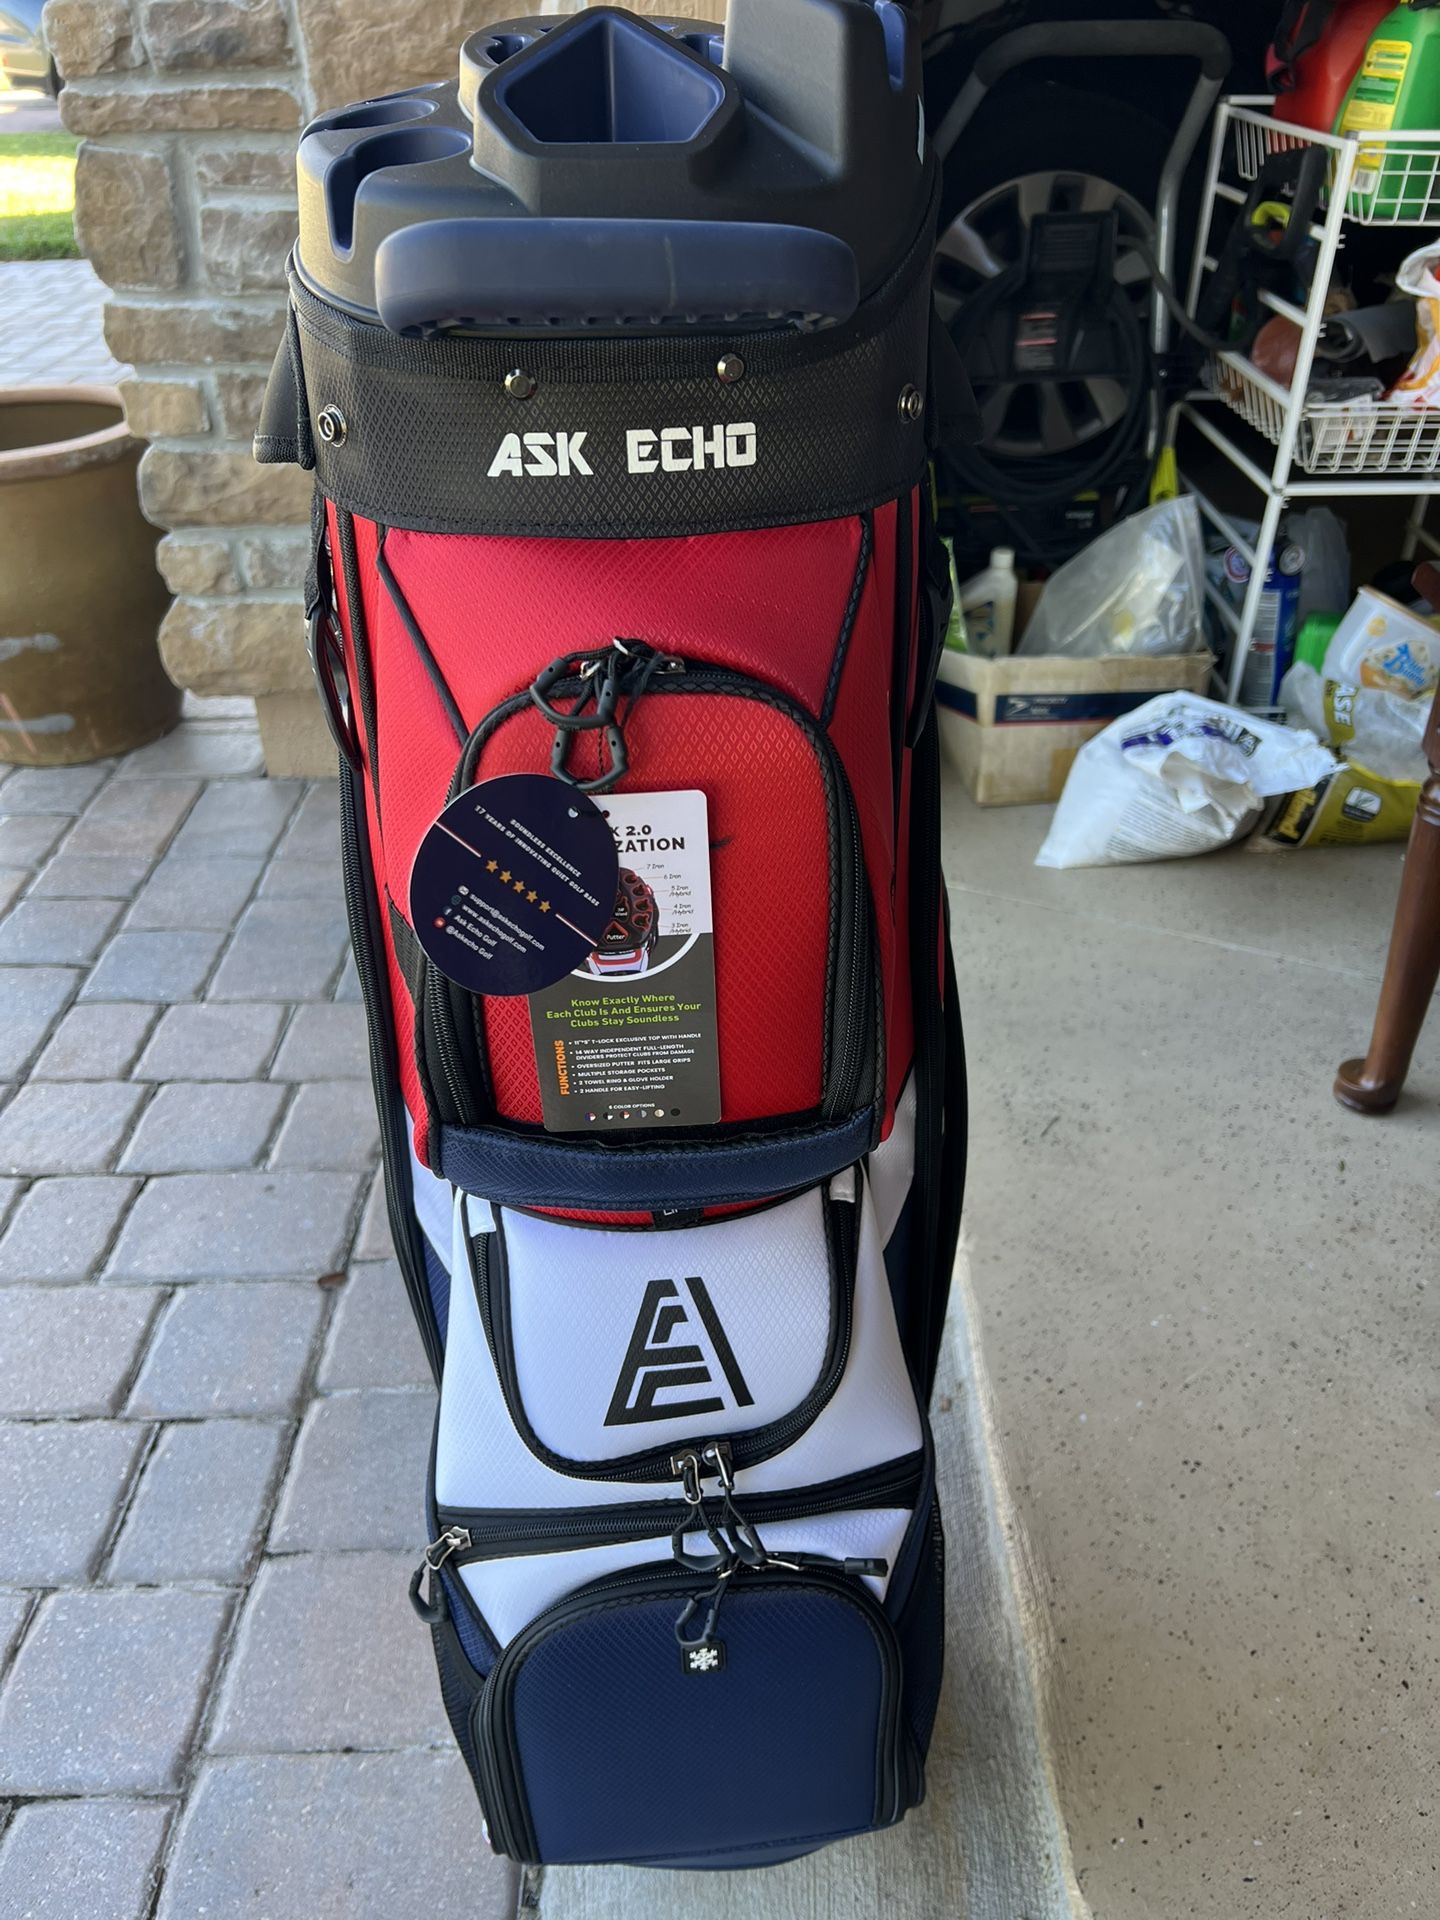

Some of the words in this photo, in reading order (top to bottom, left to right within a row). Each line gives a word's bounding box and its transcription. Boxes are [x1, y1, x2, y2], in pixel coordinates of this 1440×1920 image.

[486, 431, 594, 477] ASK
[626, 421, 757, 474] ECHO
[625, 824, 652, 836] 2.0
[474, 805, 486, 815] 17
[484, 813, 506, 833] YEARS
[505, 829, 516, 839] OF
[514, 837, 552, 868] INNOVATING
[551, 866, 570, 882] QUIET
[569, 881, 585, 894] GOLF
[583, 891, 600, 907] BAGS
[509, 819, 546, 849] SOUNDLESS
[545, 847, 582, 878] EXCELLENCE
[453, 915, 467, 927] Ask
[466, 923, 483, 938] Echo
[482, 934, 498, 947] Golf
[461, 904, 527, 953] www.askechogolf.com
[469, 893, 545, 951] support@askechogolf.com
[446, 925, 479, 951] @Askecho
[478, 947, 494, 960] Golf
[546, 1010, 571, 1019] Each
[573, 1009, 597, 1017] Club
[599, 1008, 609, 1016] Is
[611, 1006, 631, 1015] And
[633, 1005, 675, 1014] Ensures
[677, 1003, 702, 1011] Your
[571, 999, 600, 1007] Know
[602, 996, 639, 1005] Exactly
[641, 995, 675, 1003] Where
[570, 1019, 600, 1028] Clubs
[602, 1017, 625, 1026] Stay
[626, 1015, 680, 1024] Soundless
[600, 1046, 642, 1054] INDEPENDENT
[643, 1043, 684, 1051] FULL-LENGTH
[554, 1040, 570, 1095] FUNCTIONS
